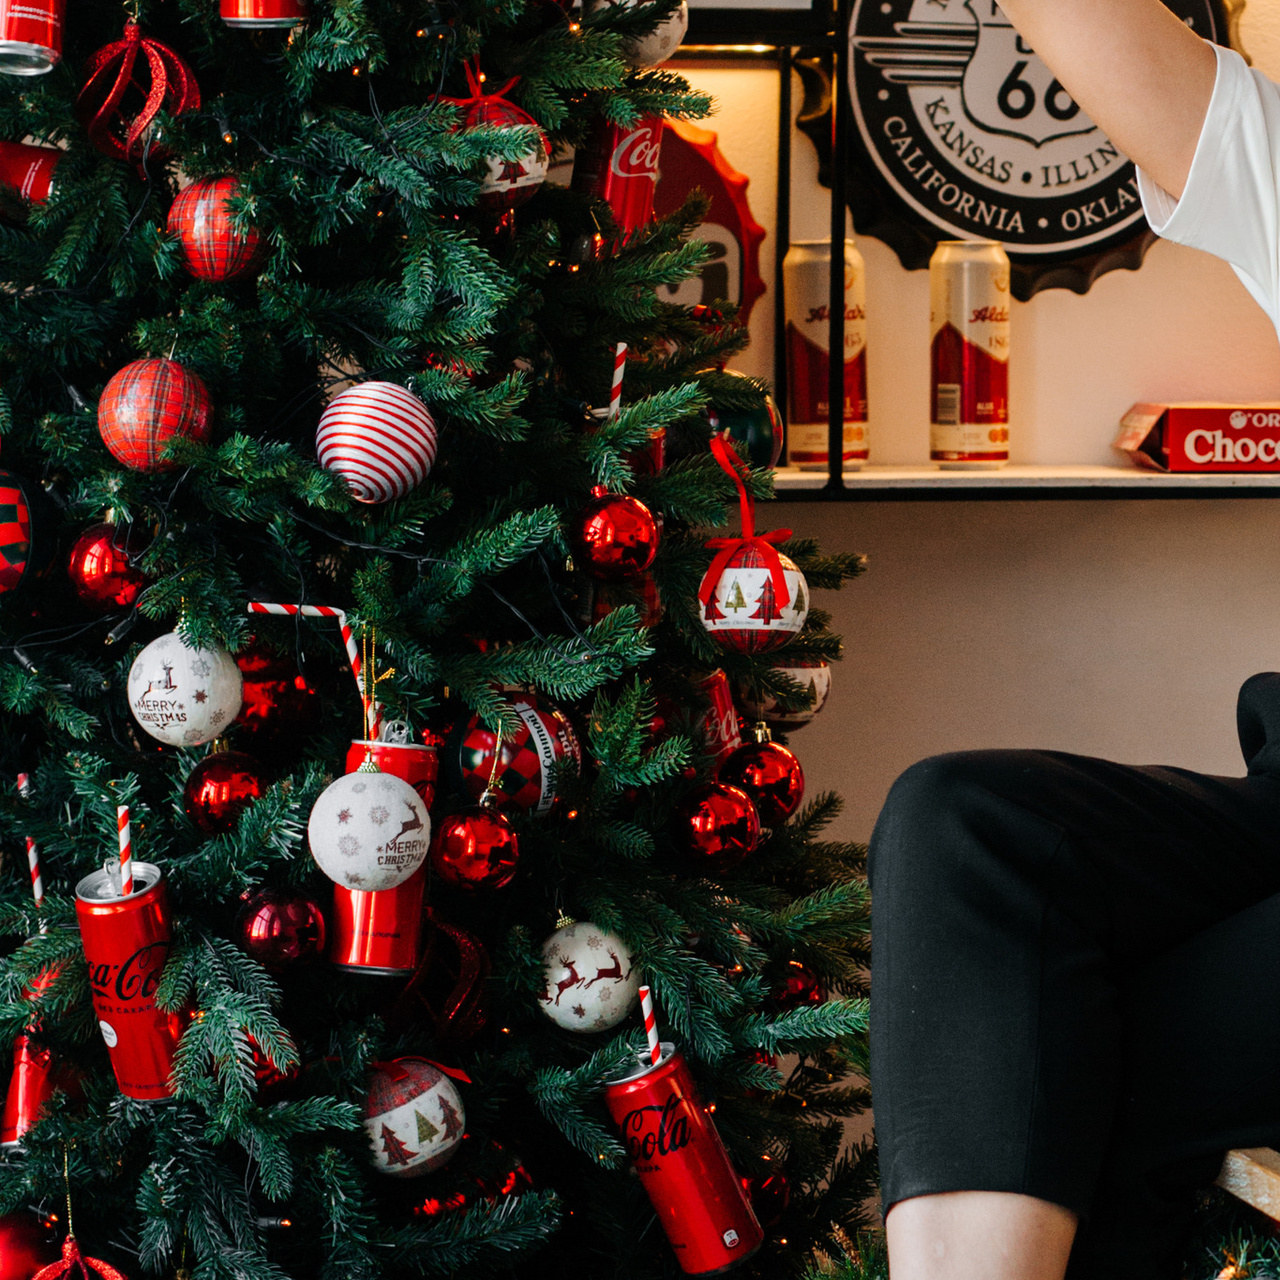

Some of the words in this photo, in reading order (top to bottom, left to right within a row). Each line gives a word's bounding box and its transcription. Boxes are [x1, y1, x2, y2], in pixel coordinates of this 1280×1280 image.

[997, 60, 1081, 122] 66
[926, 96, 1013, 184] KANSAS
[1041, 139, 1120, 188] ILLIN
[884, 116, 1026, 234] CALIFORNIA
[137, 700, 177, 712] MERRY
[385, 839, 424, 855] MERRY
